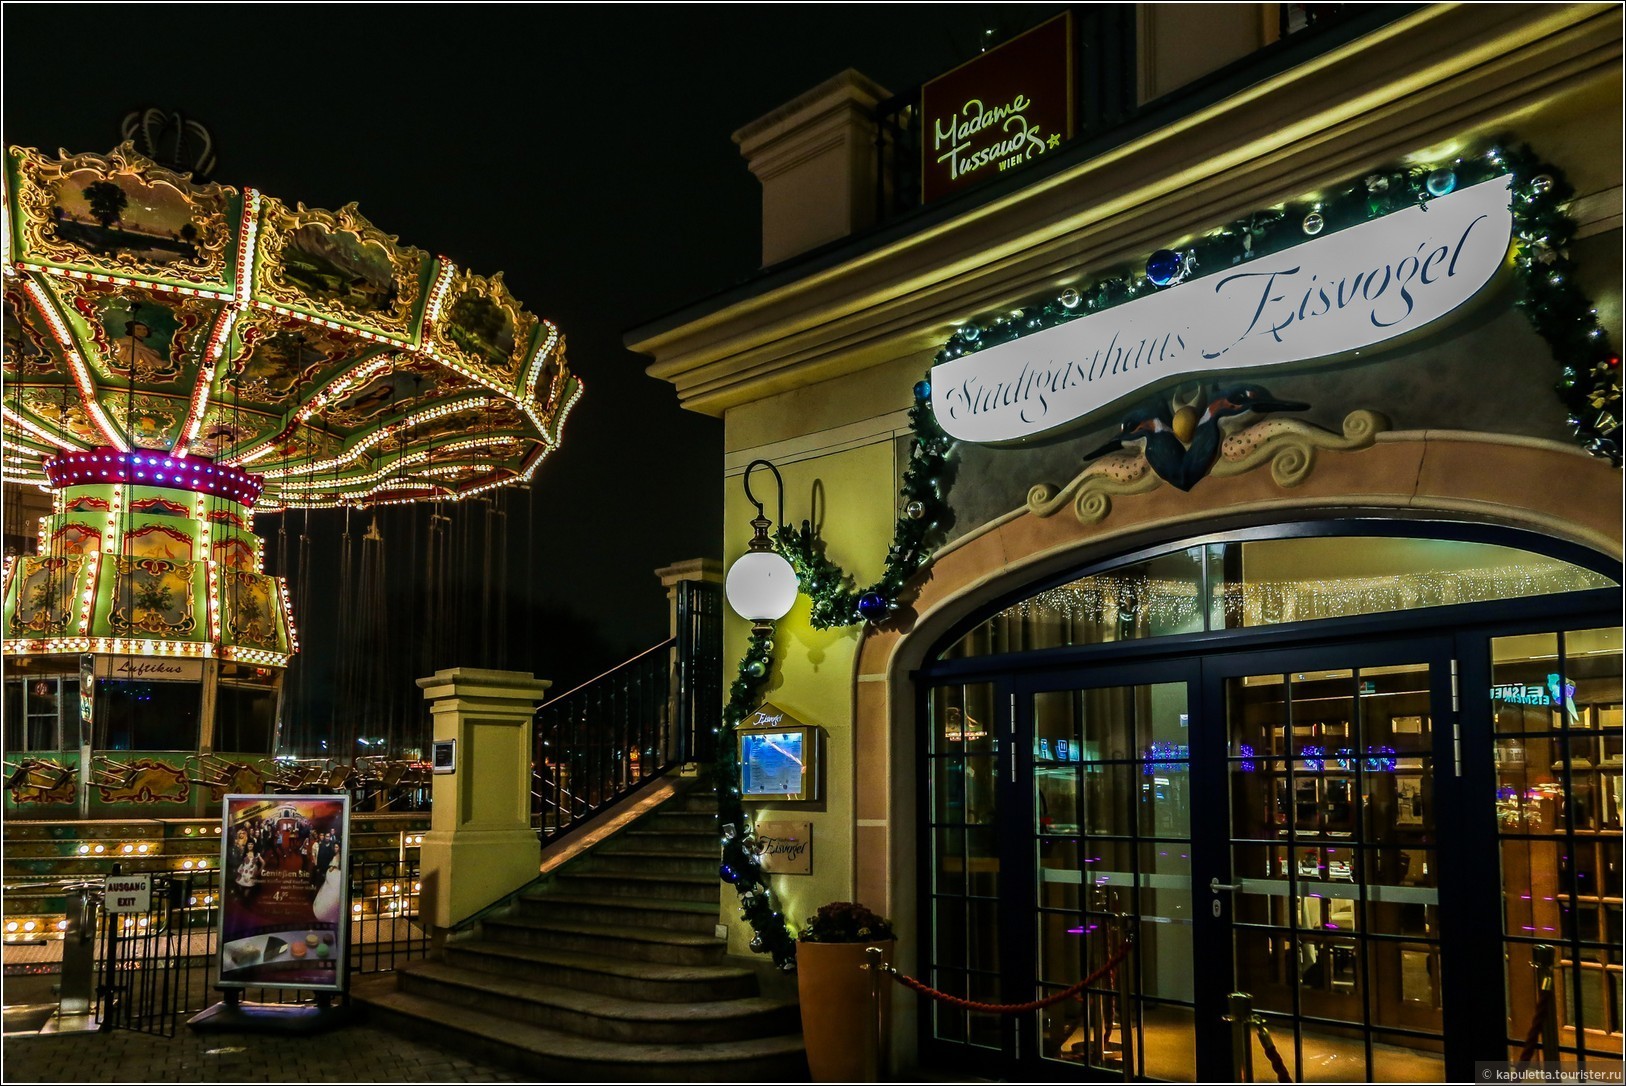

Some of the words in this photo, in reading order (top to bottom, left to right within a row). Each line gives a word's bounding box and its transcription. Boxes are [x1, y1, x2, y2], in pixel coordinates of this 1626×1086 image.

[935, 94, 1031, 150] Madame
[937, 115, 1046, 181] Tussauds
[999, 153, 1023, 172] WIEN
[946, 330, 1187, 424] Stadtgasthaus
[1201, 214, 1489, 360] Eisvogel
[117, 660, 183, 676] Luftikus
[260, 869, 297, 878] Genießen
[298, 869, 311, 878] Sie
[107, 882, 146, 892] AUSGANG
[117, 897, 136, 907] EXIT
